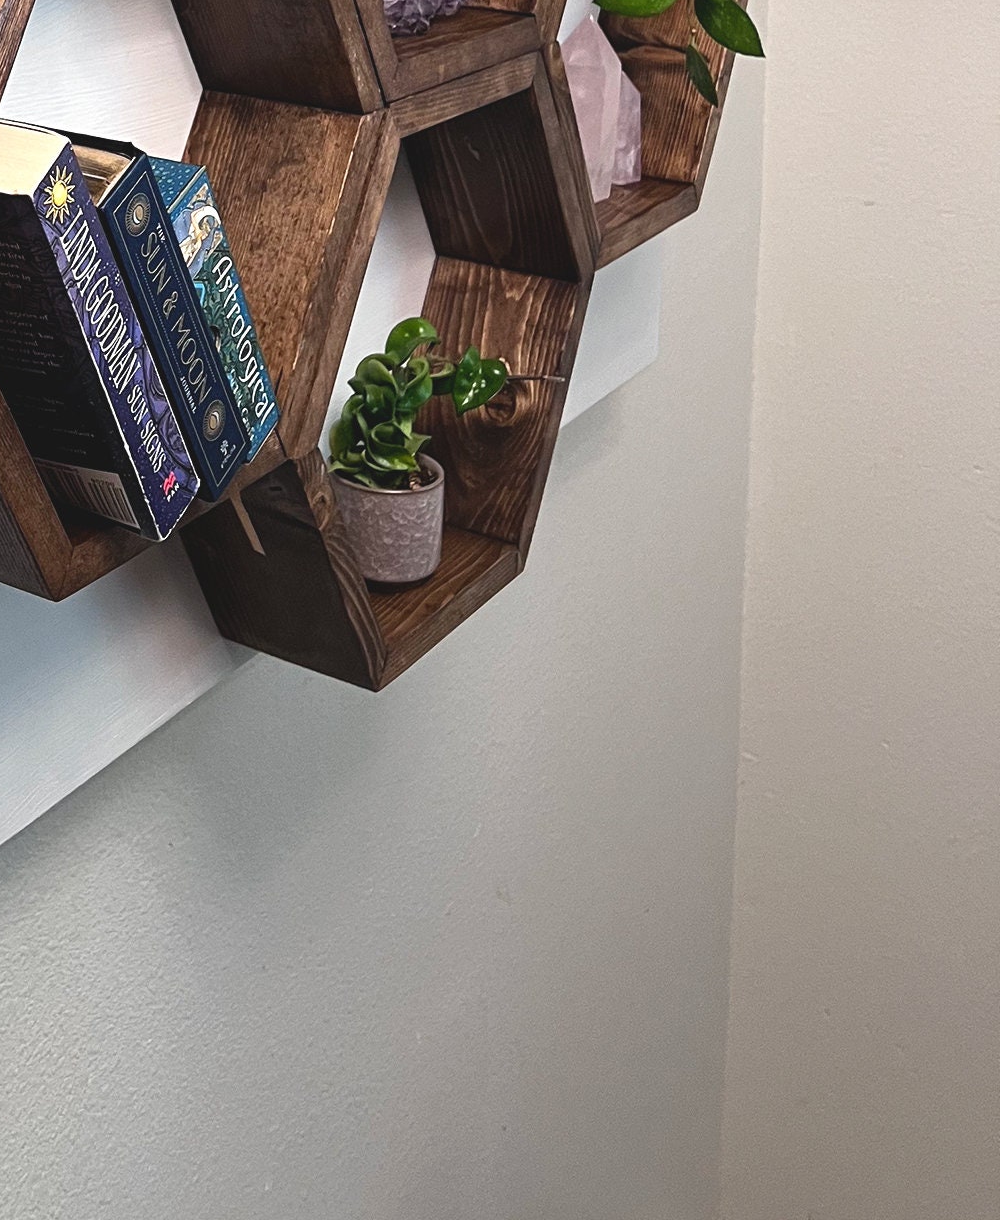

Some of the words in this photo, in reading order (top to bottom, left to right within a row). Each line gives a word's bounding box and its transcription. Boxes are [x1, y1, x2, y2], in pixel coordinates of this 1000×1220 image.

[59, 208, 102, 297] LINDA
[86, 275, 142, 395] GOODMAN
[126, 384, 149, 425] SUN
[140, 419, 166, 473] SIGNS
[141, 232, 172, 296] SUN
[162, 291, 178, 320] &
[171, 312, 213, 404] MOON
[180, 376, 197, 414] JOURNAL
[211, 255, 276, 426] Astrological
[166, 483, 180, 502] PAN
